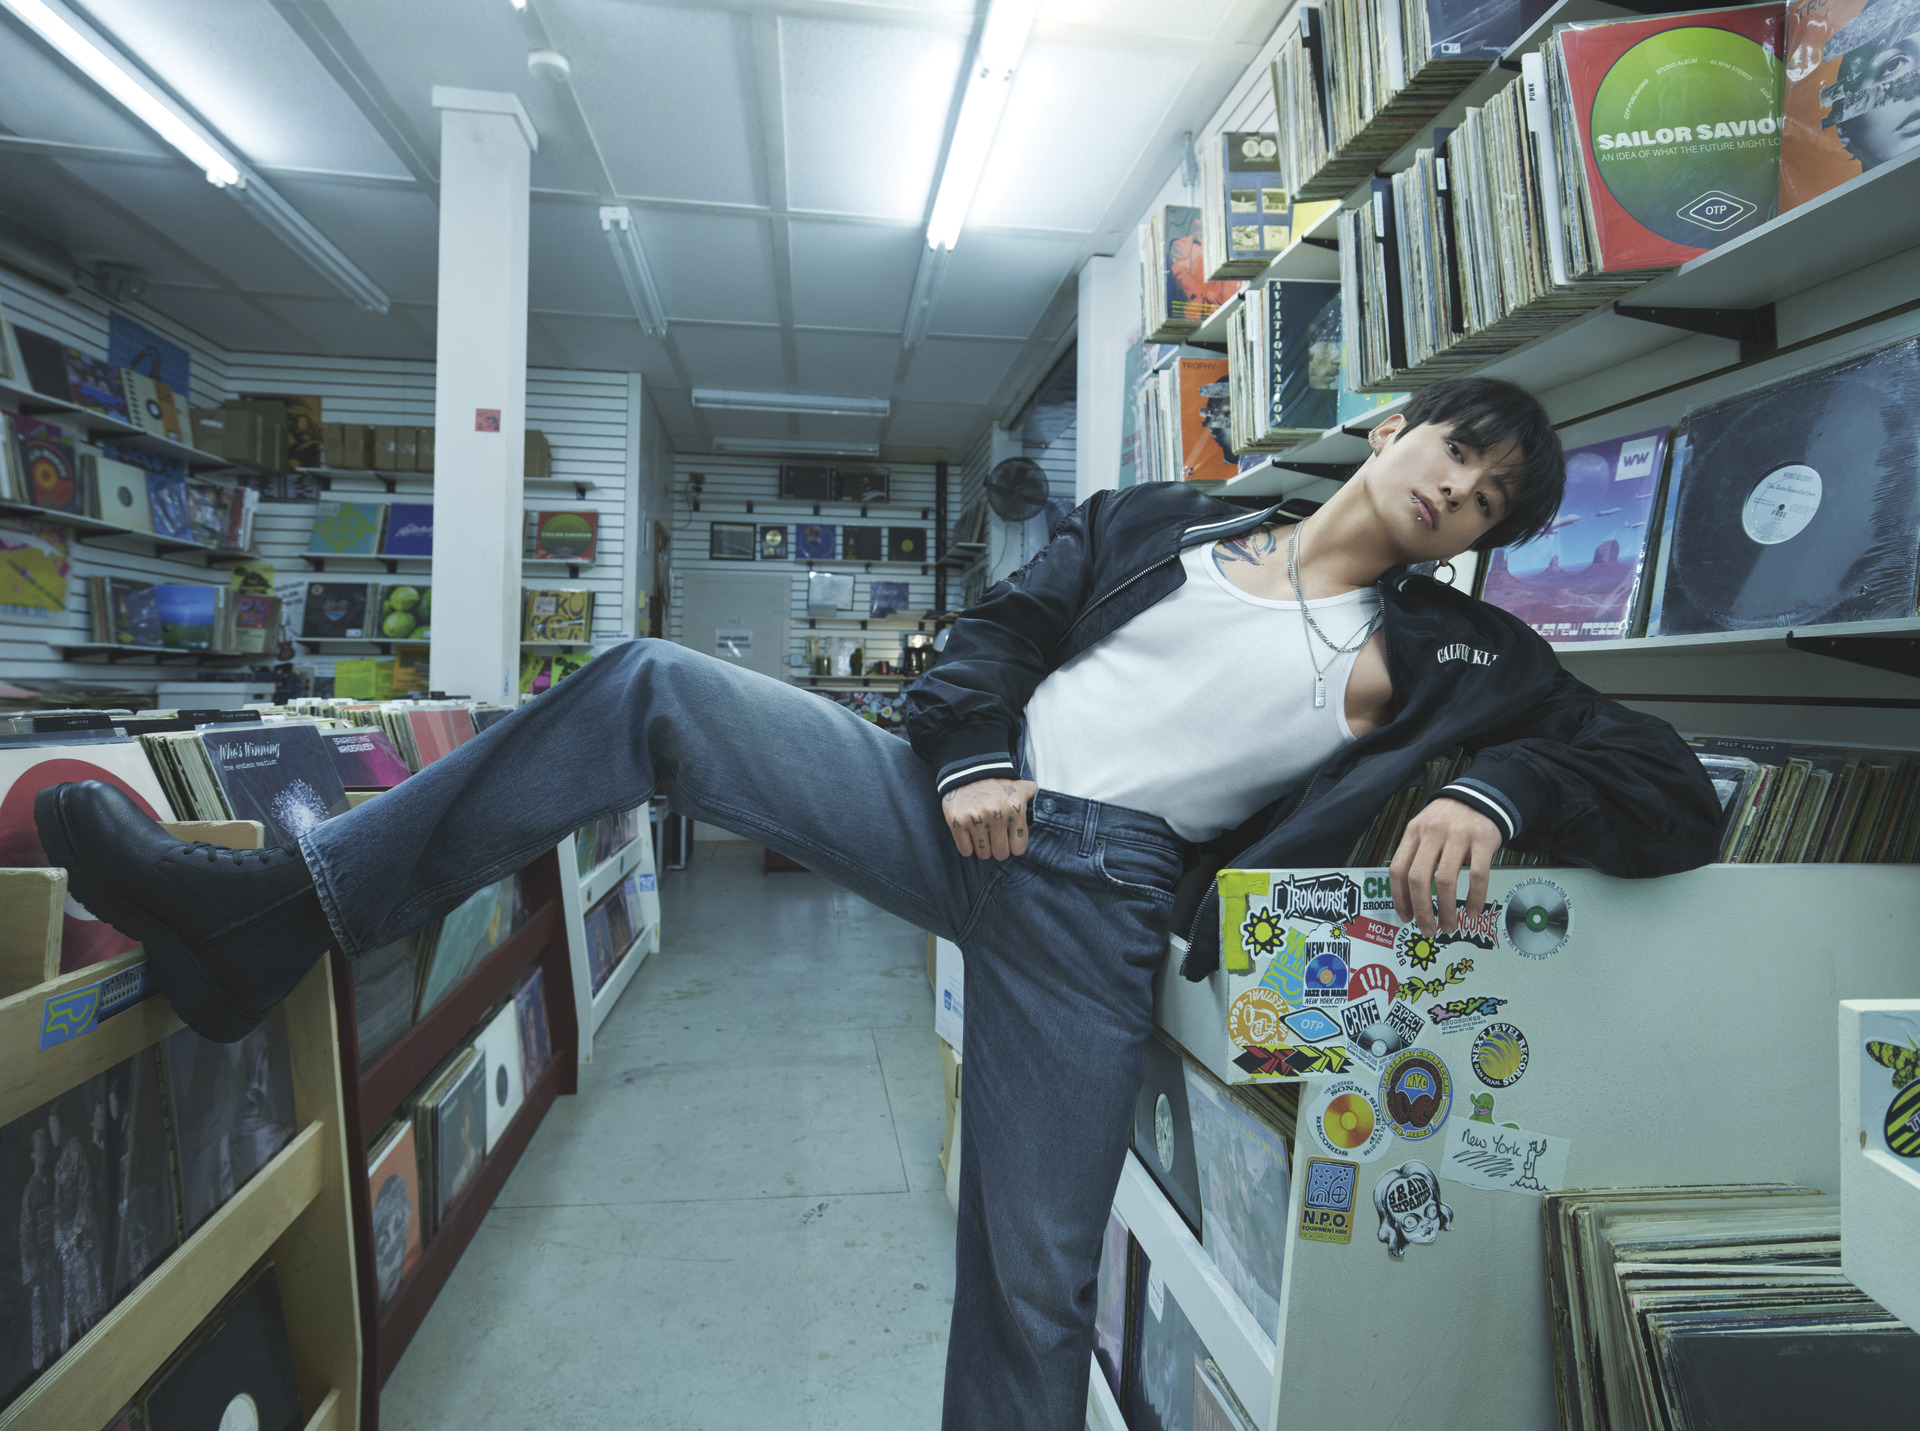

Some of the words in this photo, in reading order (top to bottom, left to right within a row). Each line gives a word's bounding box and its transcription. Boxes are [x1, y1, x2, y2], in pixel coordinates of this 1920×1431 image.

[1656, 62, 1676, 75] STUDIO
[1678, 58, 1698, 68] ALBUM
[1718, 61, 1730, 70] RPM
[1730, 65, 1752, 81] STEREO
[1528, 82, 1536, 101] PUNK
[1628, 78, 1650, 108] PUBLISHING
[1597, 126, 1692, 150] SAILOR
[1601, 154, 1614, 162] AN
[1616, 151, 1638, 160] IDEA
[1638, 150, 1651, 158] OF
[1652, 147, 1678, 158] WHAT
[1680, 144, 1698, 154] THE
[1700, 142, 1735, 152] FUTURE
[1737, 138, 1767, 149] MIGHT
[1704, 204, 1728, 216] OTP
[1273, 281, 1283, 360] AVIATION
[1182, 362, 1217, 370] TROPHY
[1623, 452, 1650, 468] WW
[1771, 510, 1788, 518] FREE
[1437, 644, 1471, 664] CALVIN
[218, 742, 243, 760] Who's
[244, 742, 281, 759] Winning
[1282, 874, 1355, 924] IRONCURSE
[1368, 922, 1394, 938] HOLA
[1306, 942, 1325, 966] NEW
[1326, 942, 1349, 966] YORK
[1396, 928, 1410, 966] BRAND
[1247, 988, 1287, 1010] FESTIVAL
[1304, 989, 1320, 997] JAZZ
[1320, 989, 1330, 997] ON
[1331, 989, 1348, 997] MAIN
[1300, 1018, 1324, 1032] OTP
[1344, 1000, 1378, 1036] CRATE
[1392, 1002, 1424, 1031] EXPECT
[1441, 1014, 1481, 1027] RECORDINGS
[1385, 1015, 1417, 1044] ATIONS
[1488, 1024, 1520, 1039] LEVEL
[1472, 1031, 1487, 1062] NEXT
[1474, 1064, 1484, 1078] SAN
[1502, 1038, 1528, 1086] RECORDS
[1331, 1080, 1354, 1090] BLEEKER
[1406, 1072, 1428, 1090] NYC
[1330, 1085, 1370, 1097] SONNY
[1369, 1096, 1381, 1126] SIDE
[1316, 1115, 1349, 1157] RECORDS
[1369, 1128, 1380, 1145] UP
[1406, 1127, 1432, 1138] HIRE
[1462, 1128, 1487, 1149] New
[1493, 1134, 1522, 1156] York
[1388, 1178, 1428, 1206] BRAIN
[1303, 1210, 1348, 1228] N.P.O.
[1302, 1225, 1334, 1234] EQUIPMENT
